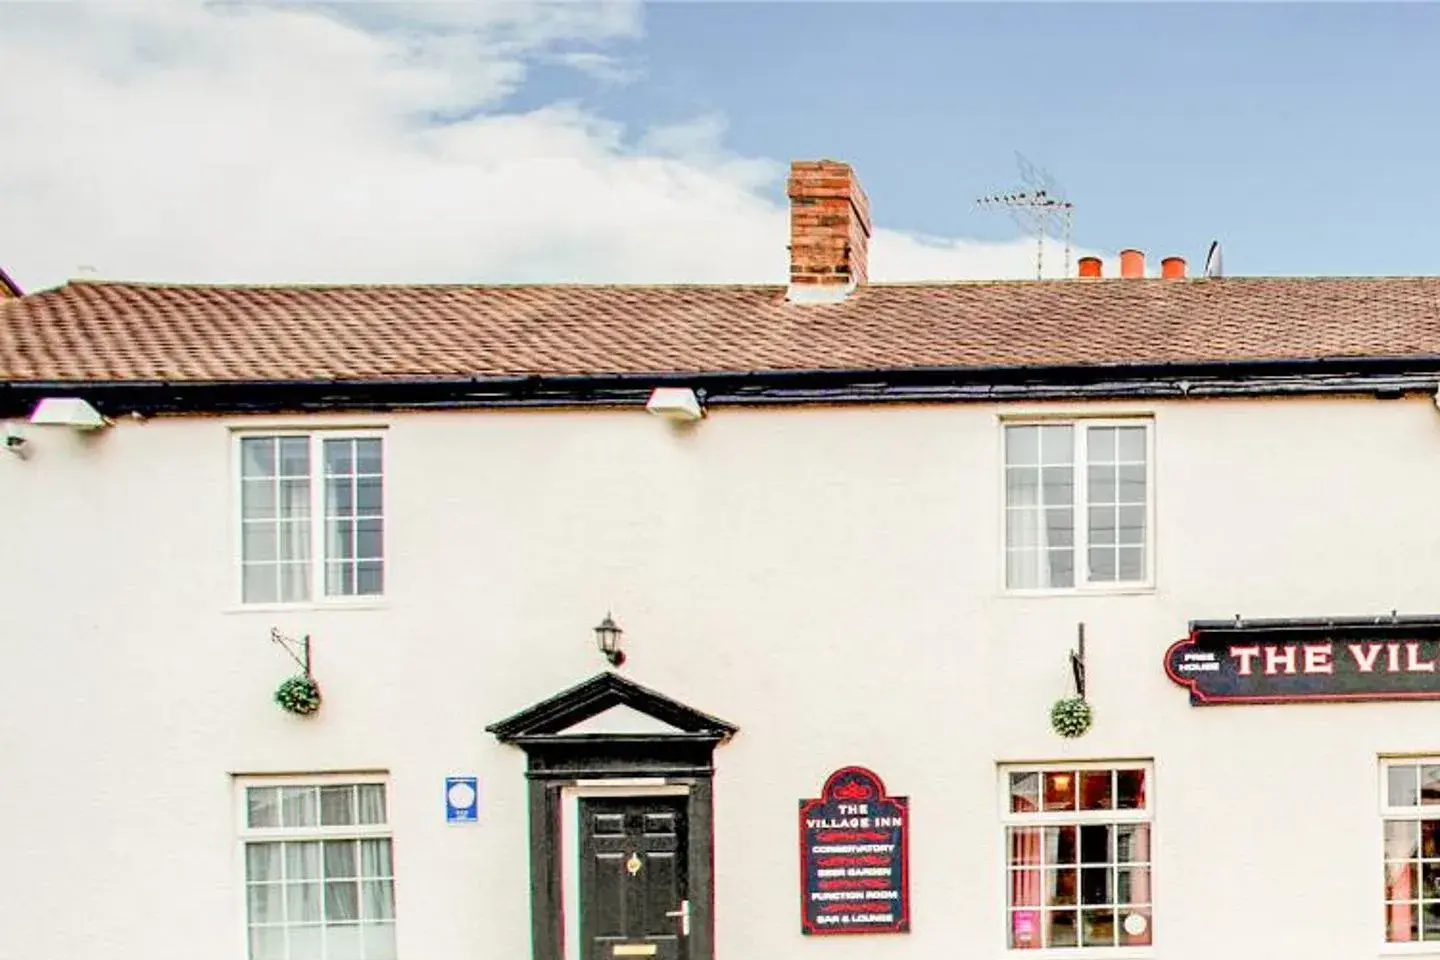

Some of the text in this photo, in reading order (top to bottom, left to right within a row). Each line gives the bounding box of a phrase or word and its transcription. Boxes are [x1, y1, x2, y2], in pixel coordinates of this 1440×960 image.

[1229, 642, 1333, 675] THE
[1179, 662, 1220, 671] HOUSE
[838, 803, 868, 815] THE
[806, 817, 902, 828] VILLAGE INN
[865, 890, 898, 899] ROOM
